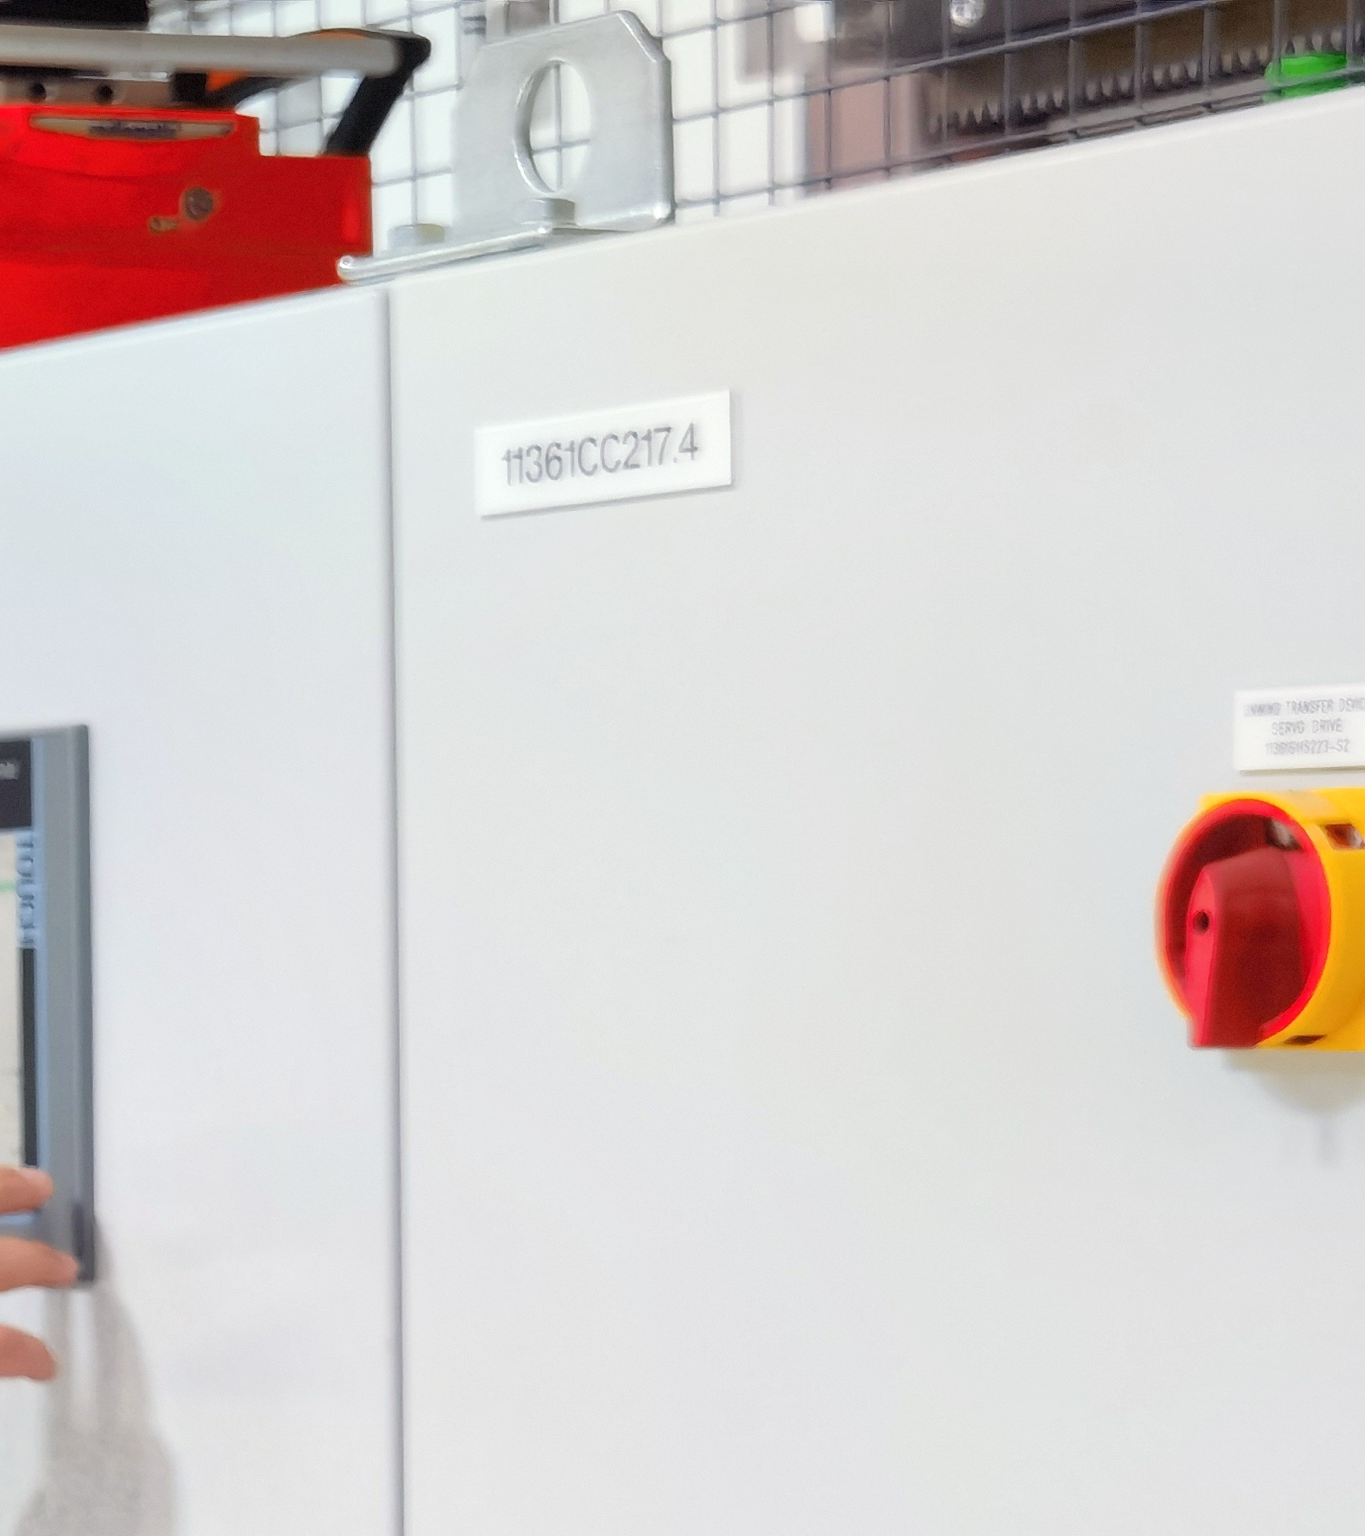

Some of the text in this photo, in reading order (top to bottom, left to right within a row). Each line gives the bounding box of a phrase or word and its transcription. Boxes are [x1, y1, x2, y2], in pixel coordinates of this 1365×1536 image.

[501, 422, 698, 487] 11361CC217.4
[1271, 718, 1343, 736] SERVO DRIVE
